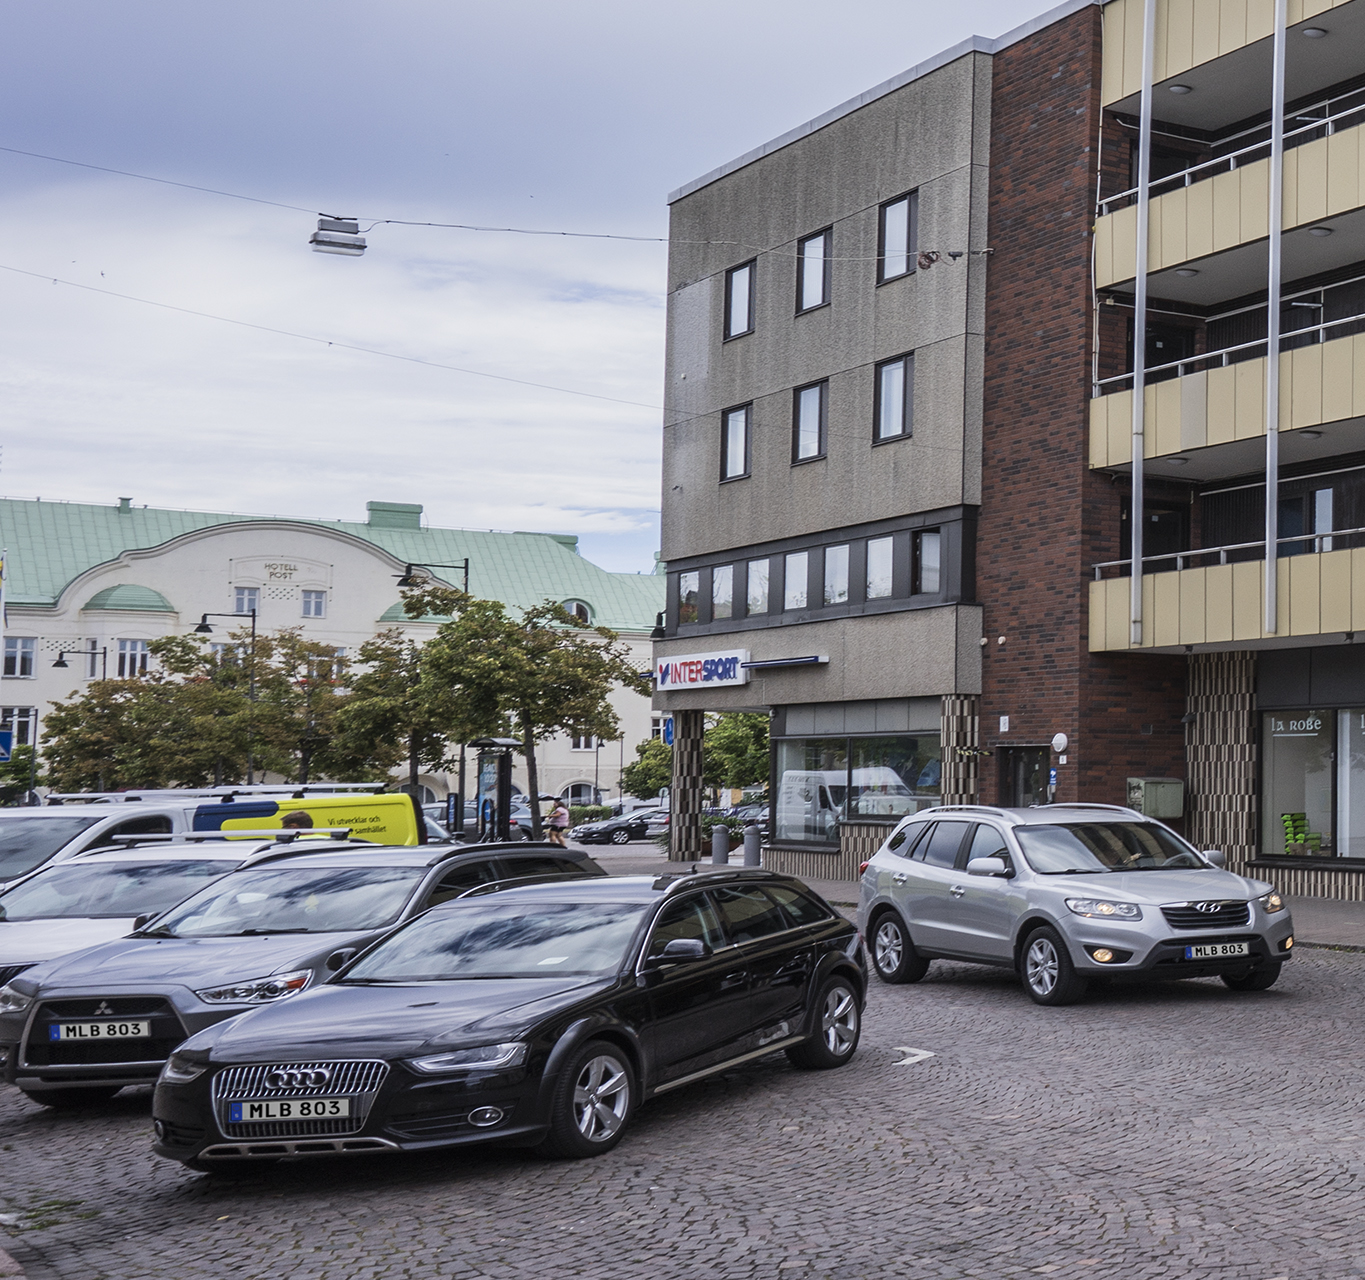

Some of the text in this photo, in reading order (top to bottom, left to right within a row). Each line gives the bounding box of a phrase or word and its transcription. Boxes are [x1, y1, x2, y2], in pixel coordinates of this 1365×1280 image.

[264, 563, 299, 571] HOTELL
[269, 571, 293, 580] POST
[671, 656, 741, 684] INTERSPORT
[336, 817, 367, 825] utvecklar
[368, 815, 381, 823] och
[1195, 944, 1244, 956] MLB 803
[66, 1023, 141, 1037] MLB 803
[250, 1101, 340, 1118] MLB 803
